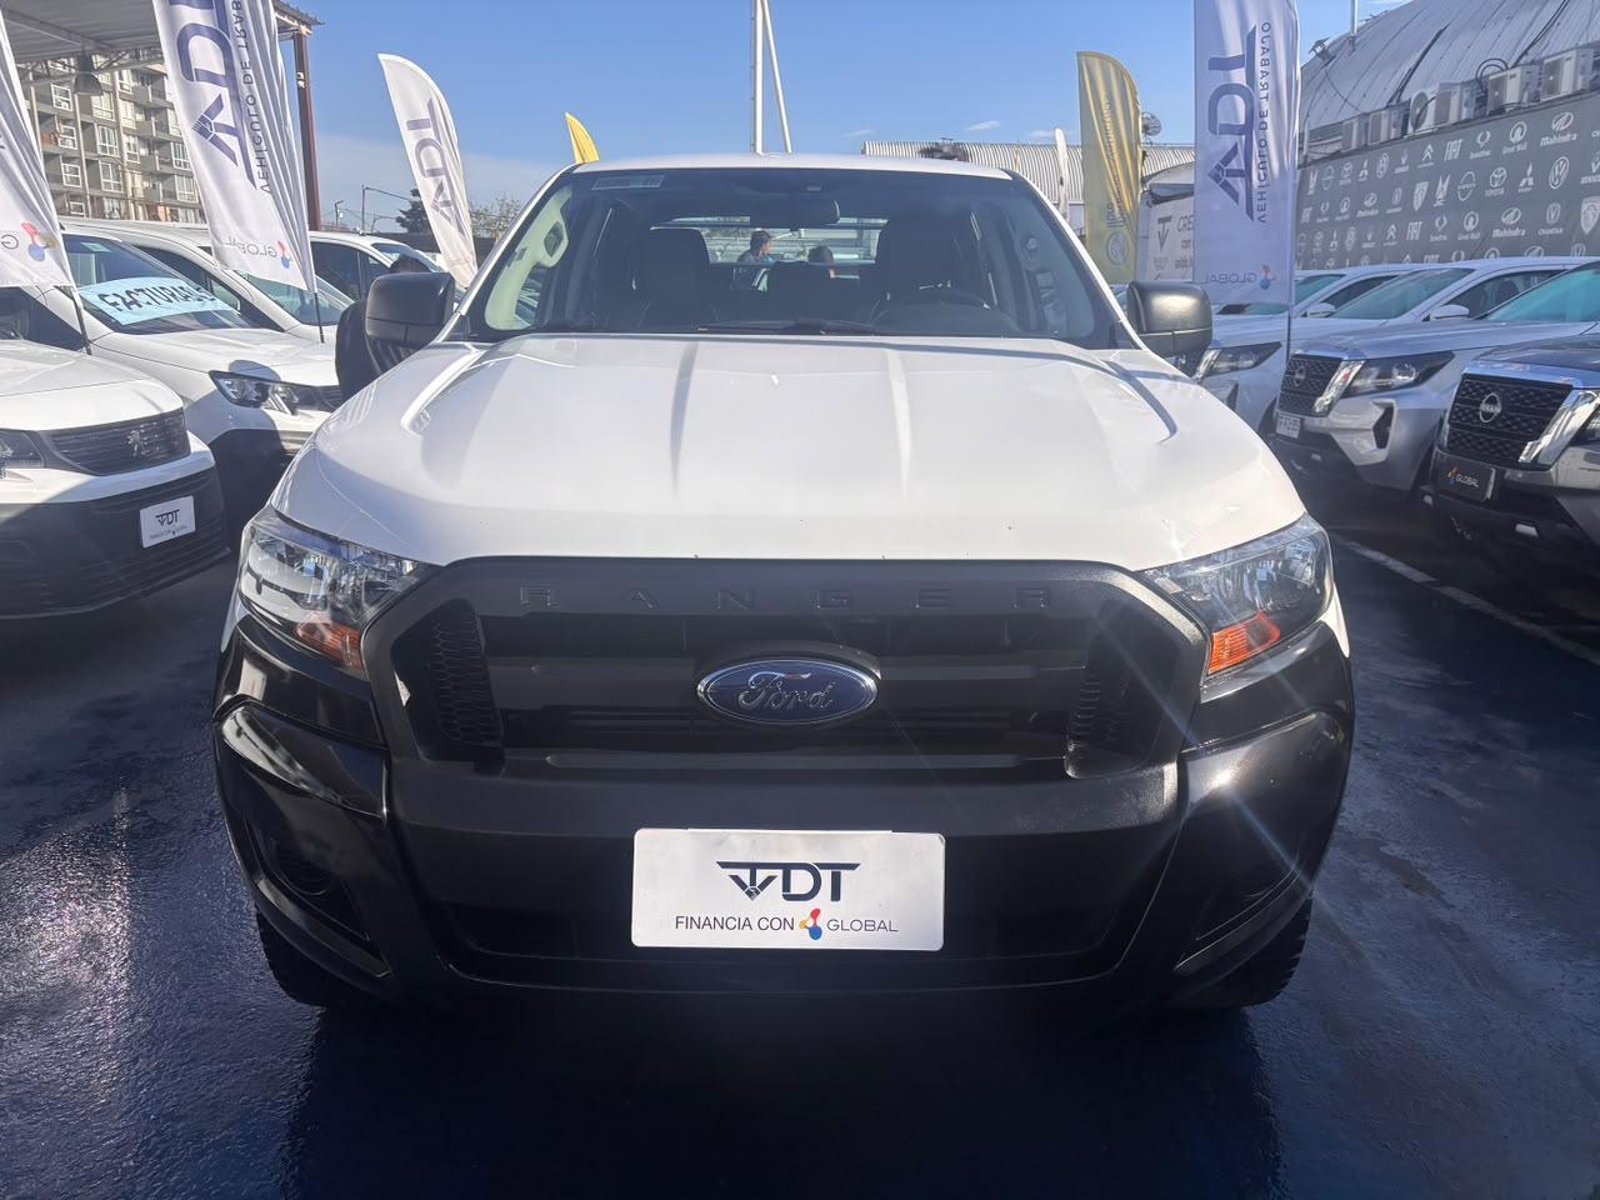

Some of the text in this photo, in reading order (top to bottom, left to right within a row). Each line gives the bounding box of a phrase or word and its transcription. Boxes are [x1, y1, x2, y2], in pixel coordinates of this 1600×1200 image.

[519, 584, 1053, 609] RANGER
[738, 670, 835, 711] Ford
[674, 915, 899, 933] FINANCIA CON GLOBAL
